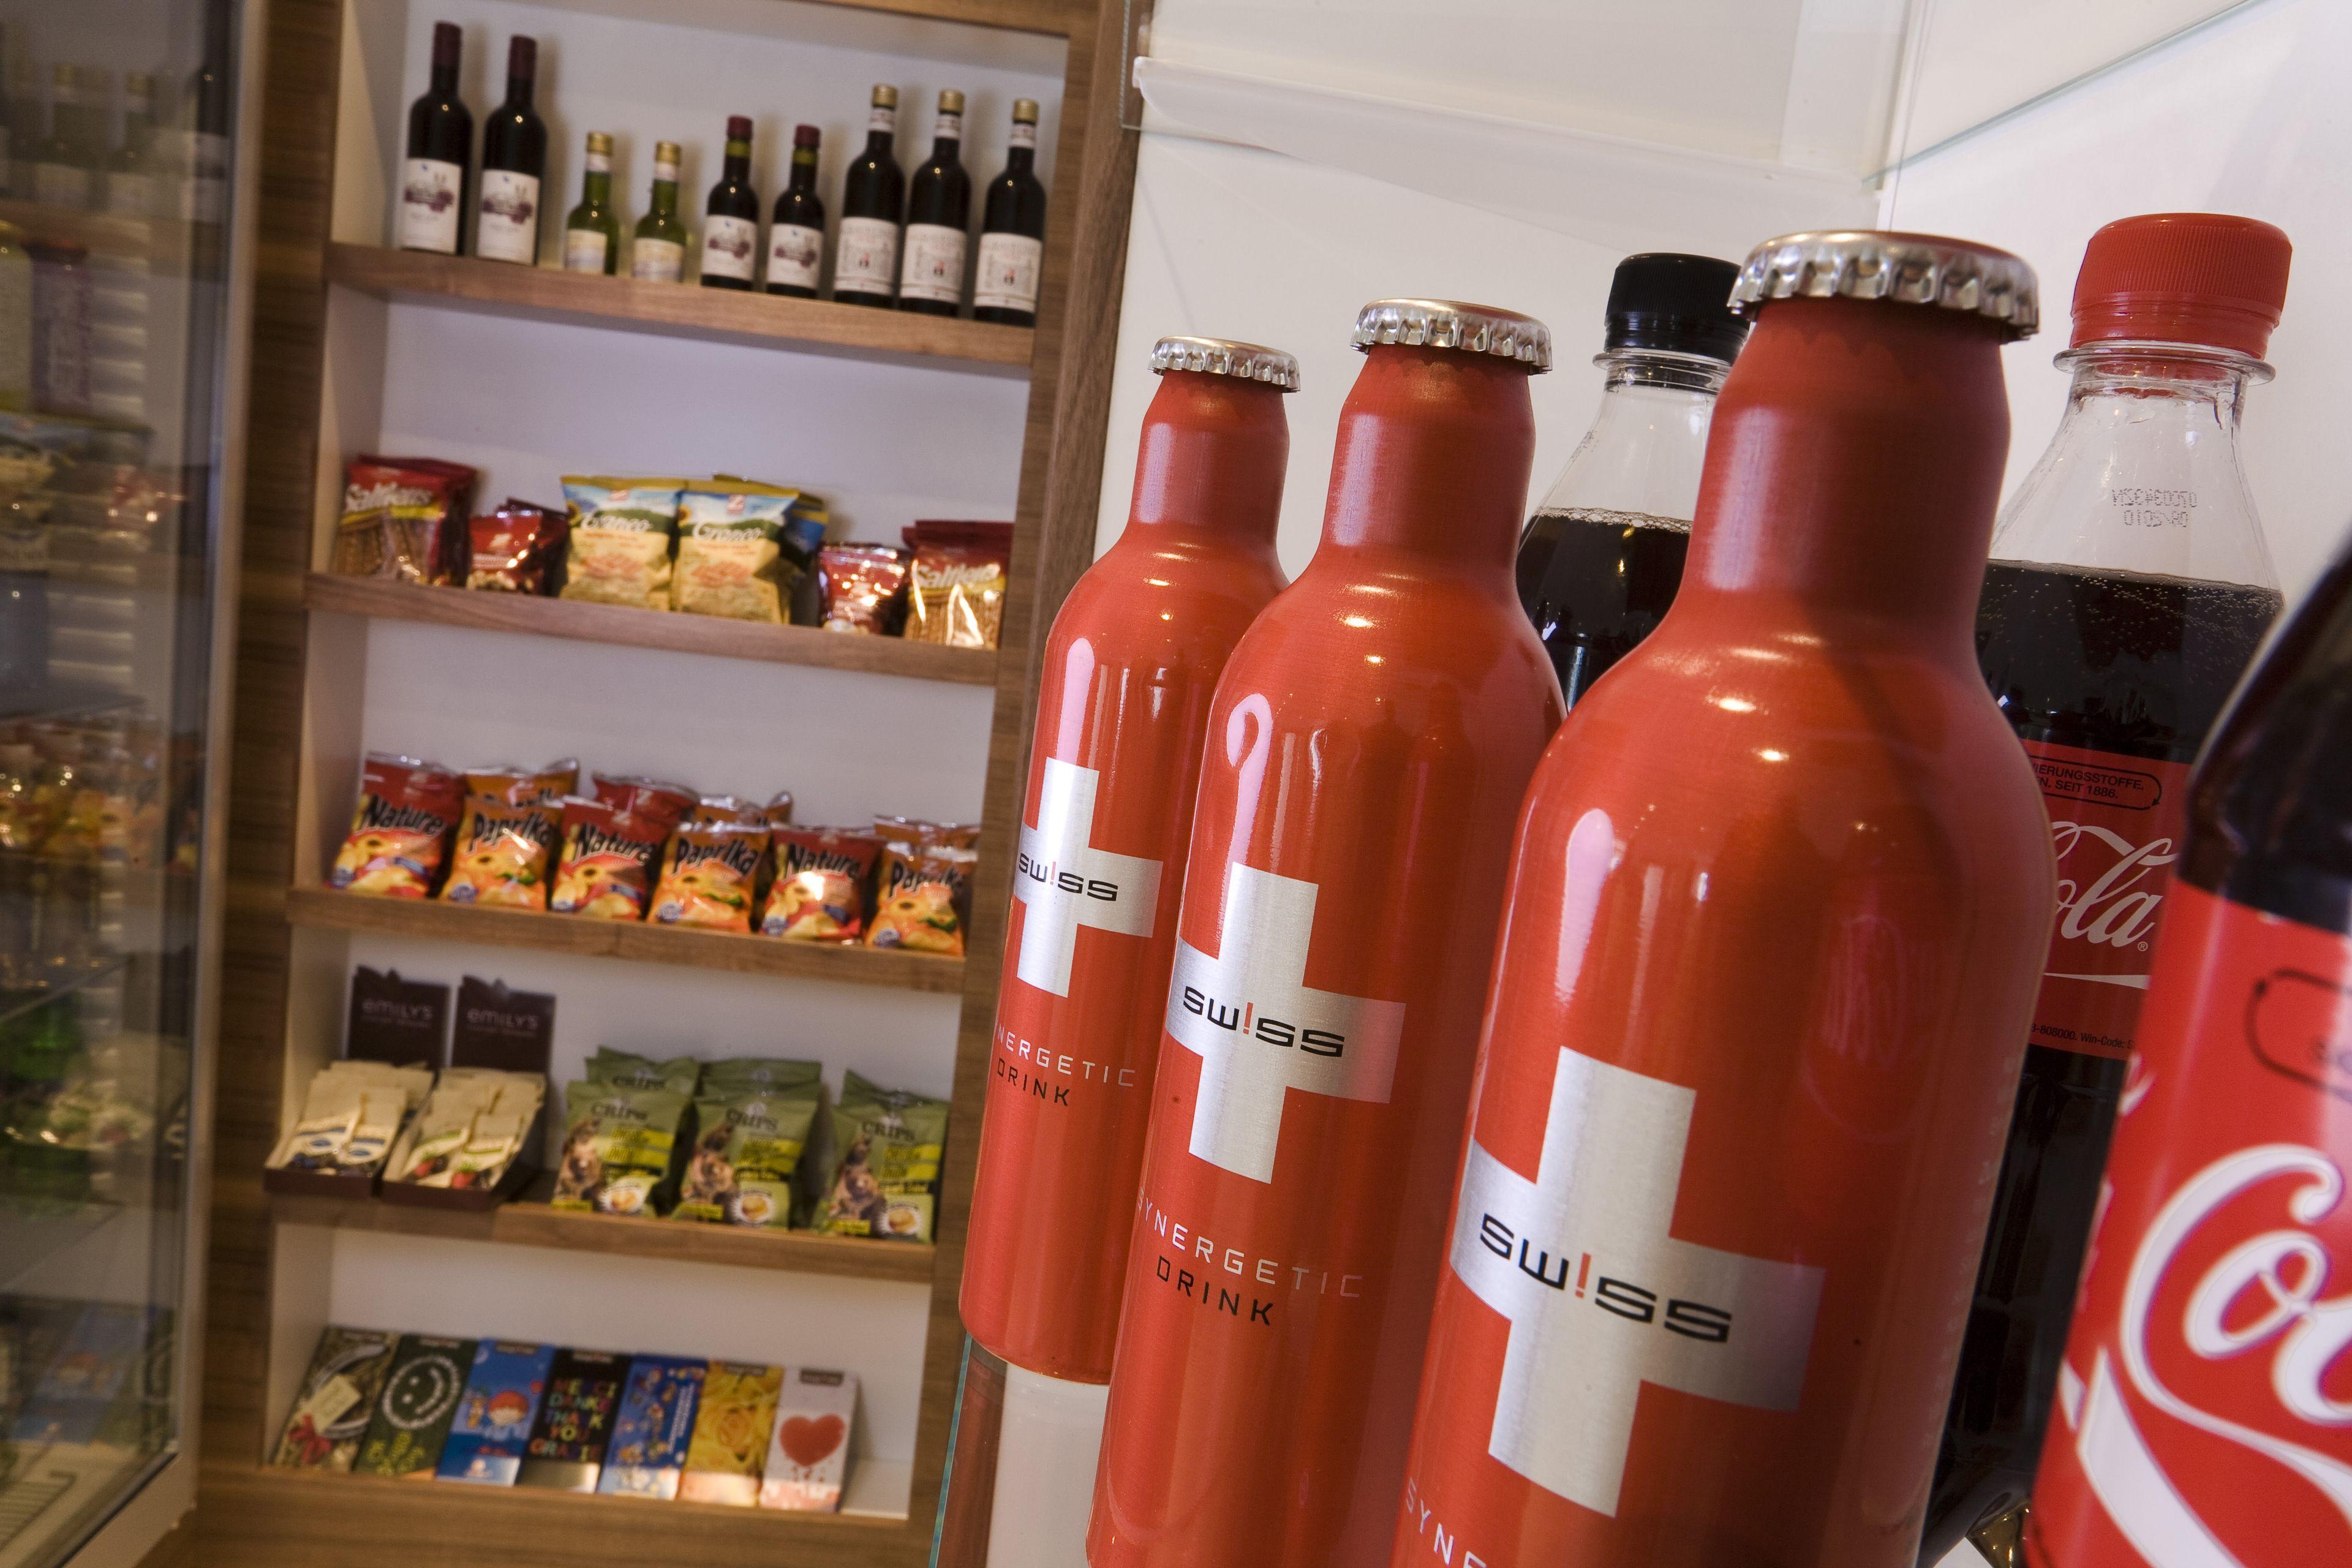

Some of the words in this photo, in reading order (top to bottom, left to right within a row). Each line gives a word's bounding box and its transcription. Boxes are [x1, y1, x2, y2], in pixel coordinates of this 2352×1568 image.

[2055, 780, 2084, 793] SEIT
[2087, 785, 2119, 799] 1886.
[362, 796, 445, 837] Nature
[576, 822, 658, 862] Nature
[674, 839, 760, 878] Paprika
[787, 843, 862, 880] Nature
[995, 1019, 1137, 1088] NERGETIC
[2081, 1032, 2125, 1048] Win-Code:
[996, 1058, 1072, 1107] DRINK
[1156, 1255, 1276, 1326] DRINK
